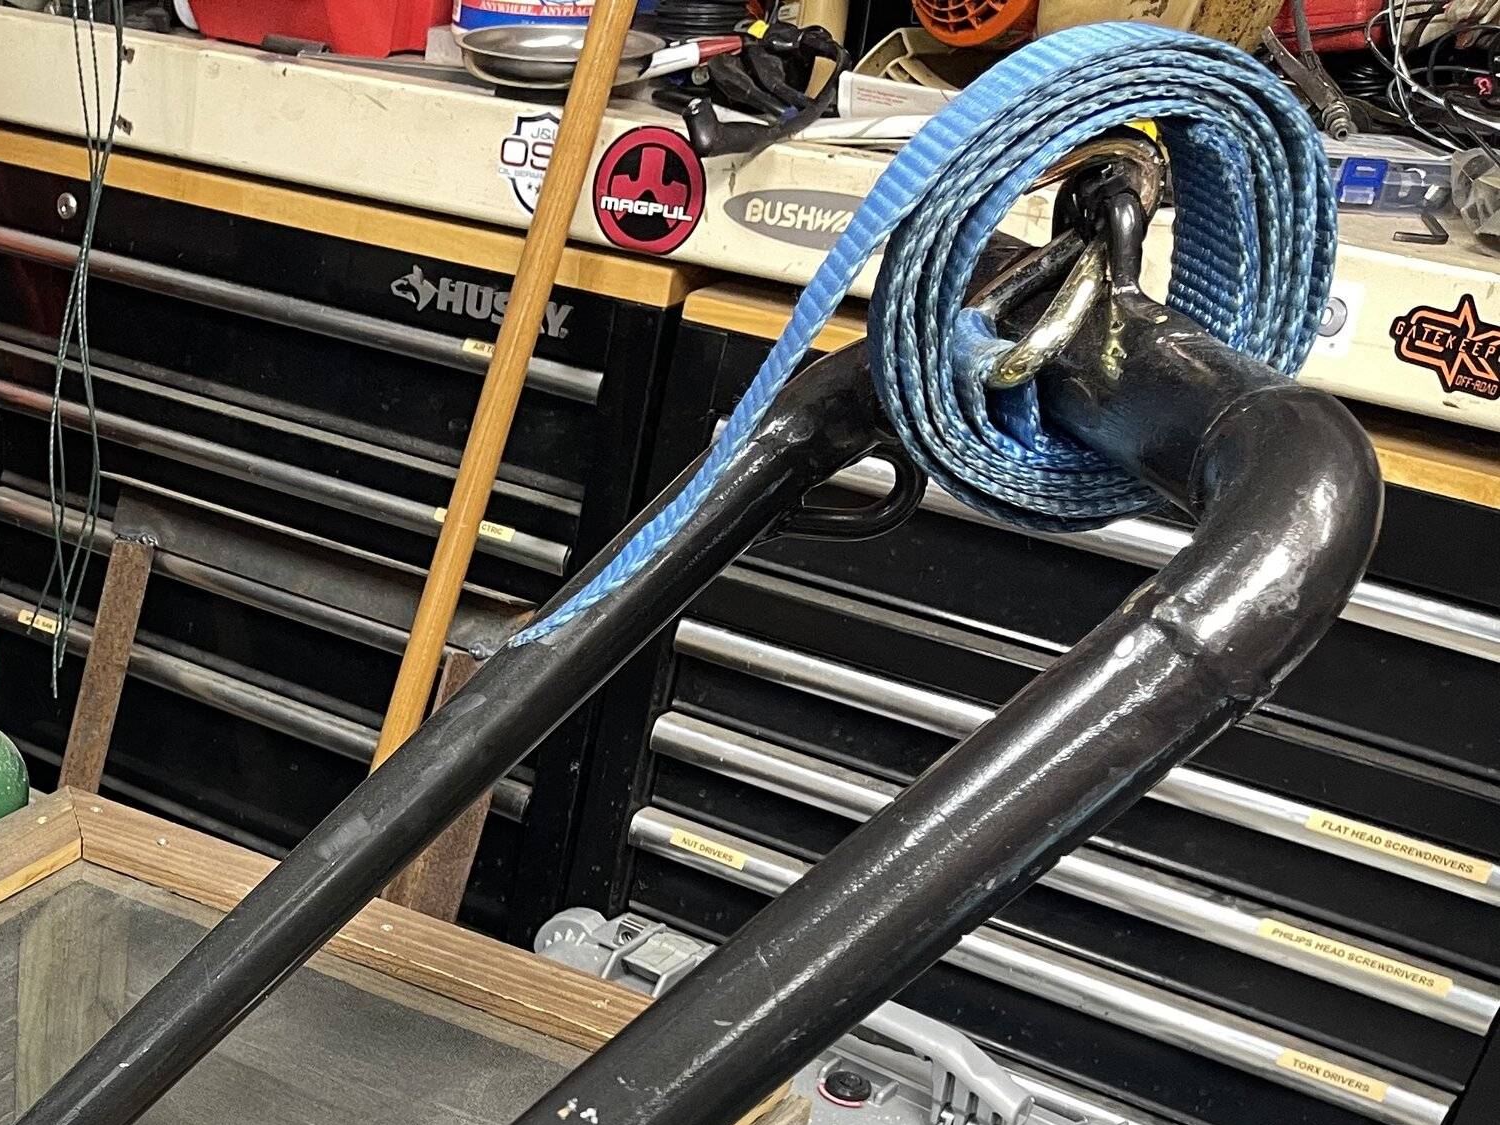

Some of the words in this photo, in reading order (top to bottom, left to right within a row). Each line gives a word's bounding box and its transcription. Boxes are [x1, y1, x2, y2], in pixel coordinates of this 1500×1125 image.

[501, 137, 555, 170] OS
[600, 195, 693, 222] MAGPUL
[744, 197, 854, 233] BUSHWA
[436, 277, 574, 338] HUSY
[1395, 320, 1500, 363] GATEKEEP
[1454, 375, 1498, 396] OFF-ROAD
[481, 523, 504, 536] CTRIC
[681, 837, 699, 851] NUT
[700, 843, 734, 863] DRIVERS
[1321, 820, 1350, 835] FLAT
[1350, 829, 1383, 846] HEAD
[1384, 839, 1474, 874] SCREWDRIVERS
[1315, 941, 1345, 958] HEAD
[1347, 952, 1435, 988] SCREWDRIVERS
[1293, 1058, 1321, 1076] TORX
[1323, 1067, 1370, 1092] DRIVERS
